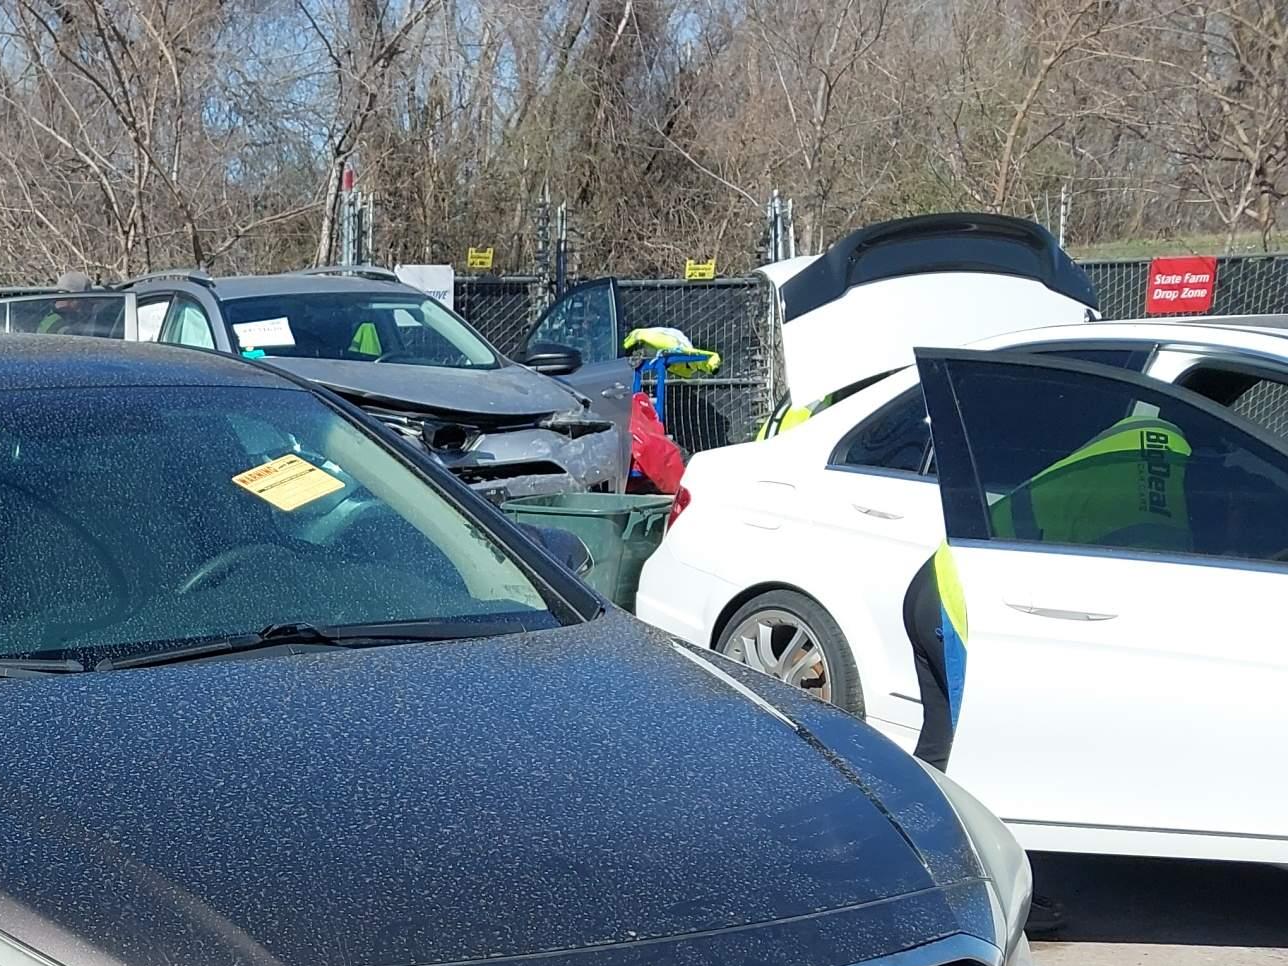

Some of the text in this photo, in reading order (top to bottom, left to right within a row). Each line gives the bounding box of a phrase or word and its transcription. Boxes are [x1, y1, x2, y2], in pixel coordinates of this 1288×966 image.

[1154, 273, 1210, 285] State Farm
[1153, 288, 1208, 301] Drop Zone
